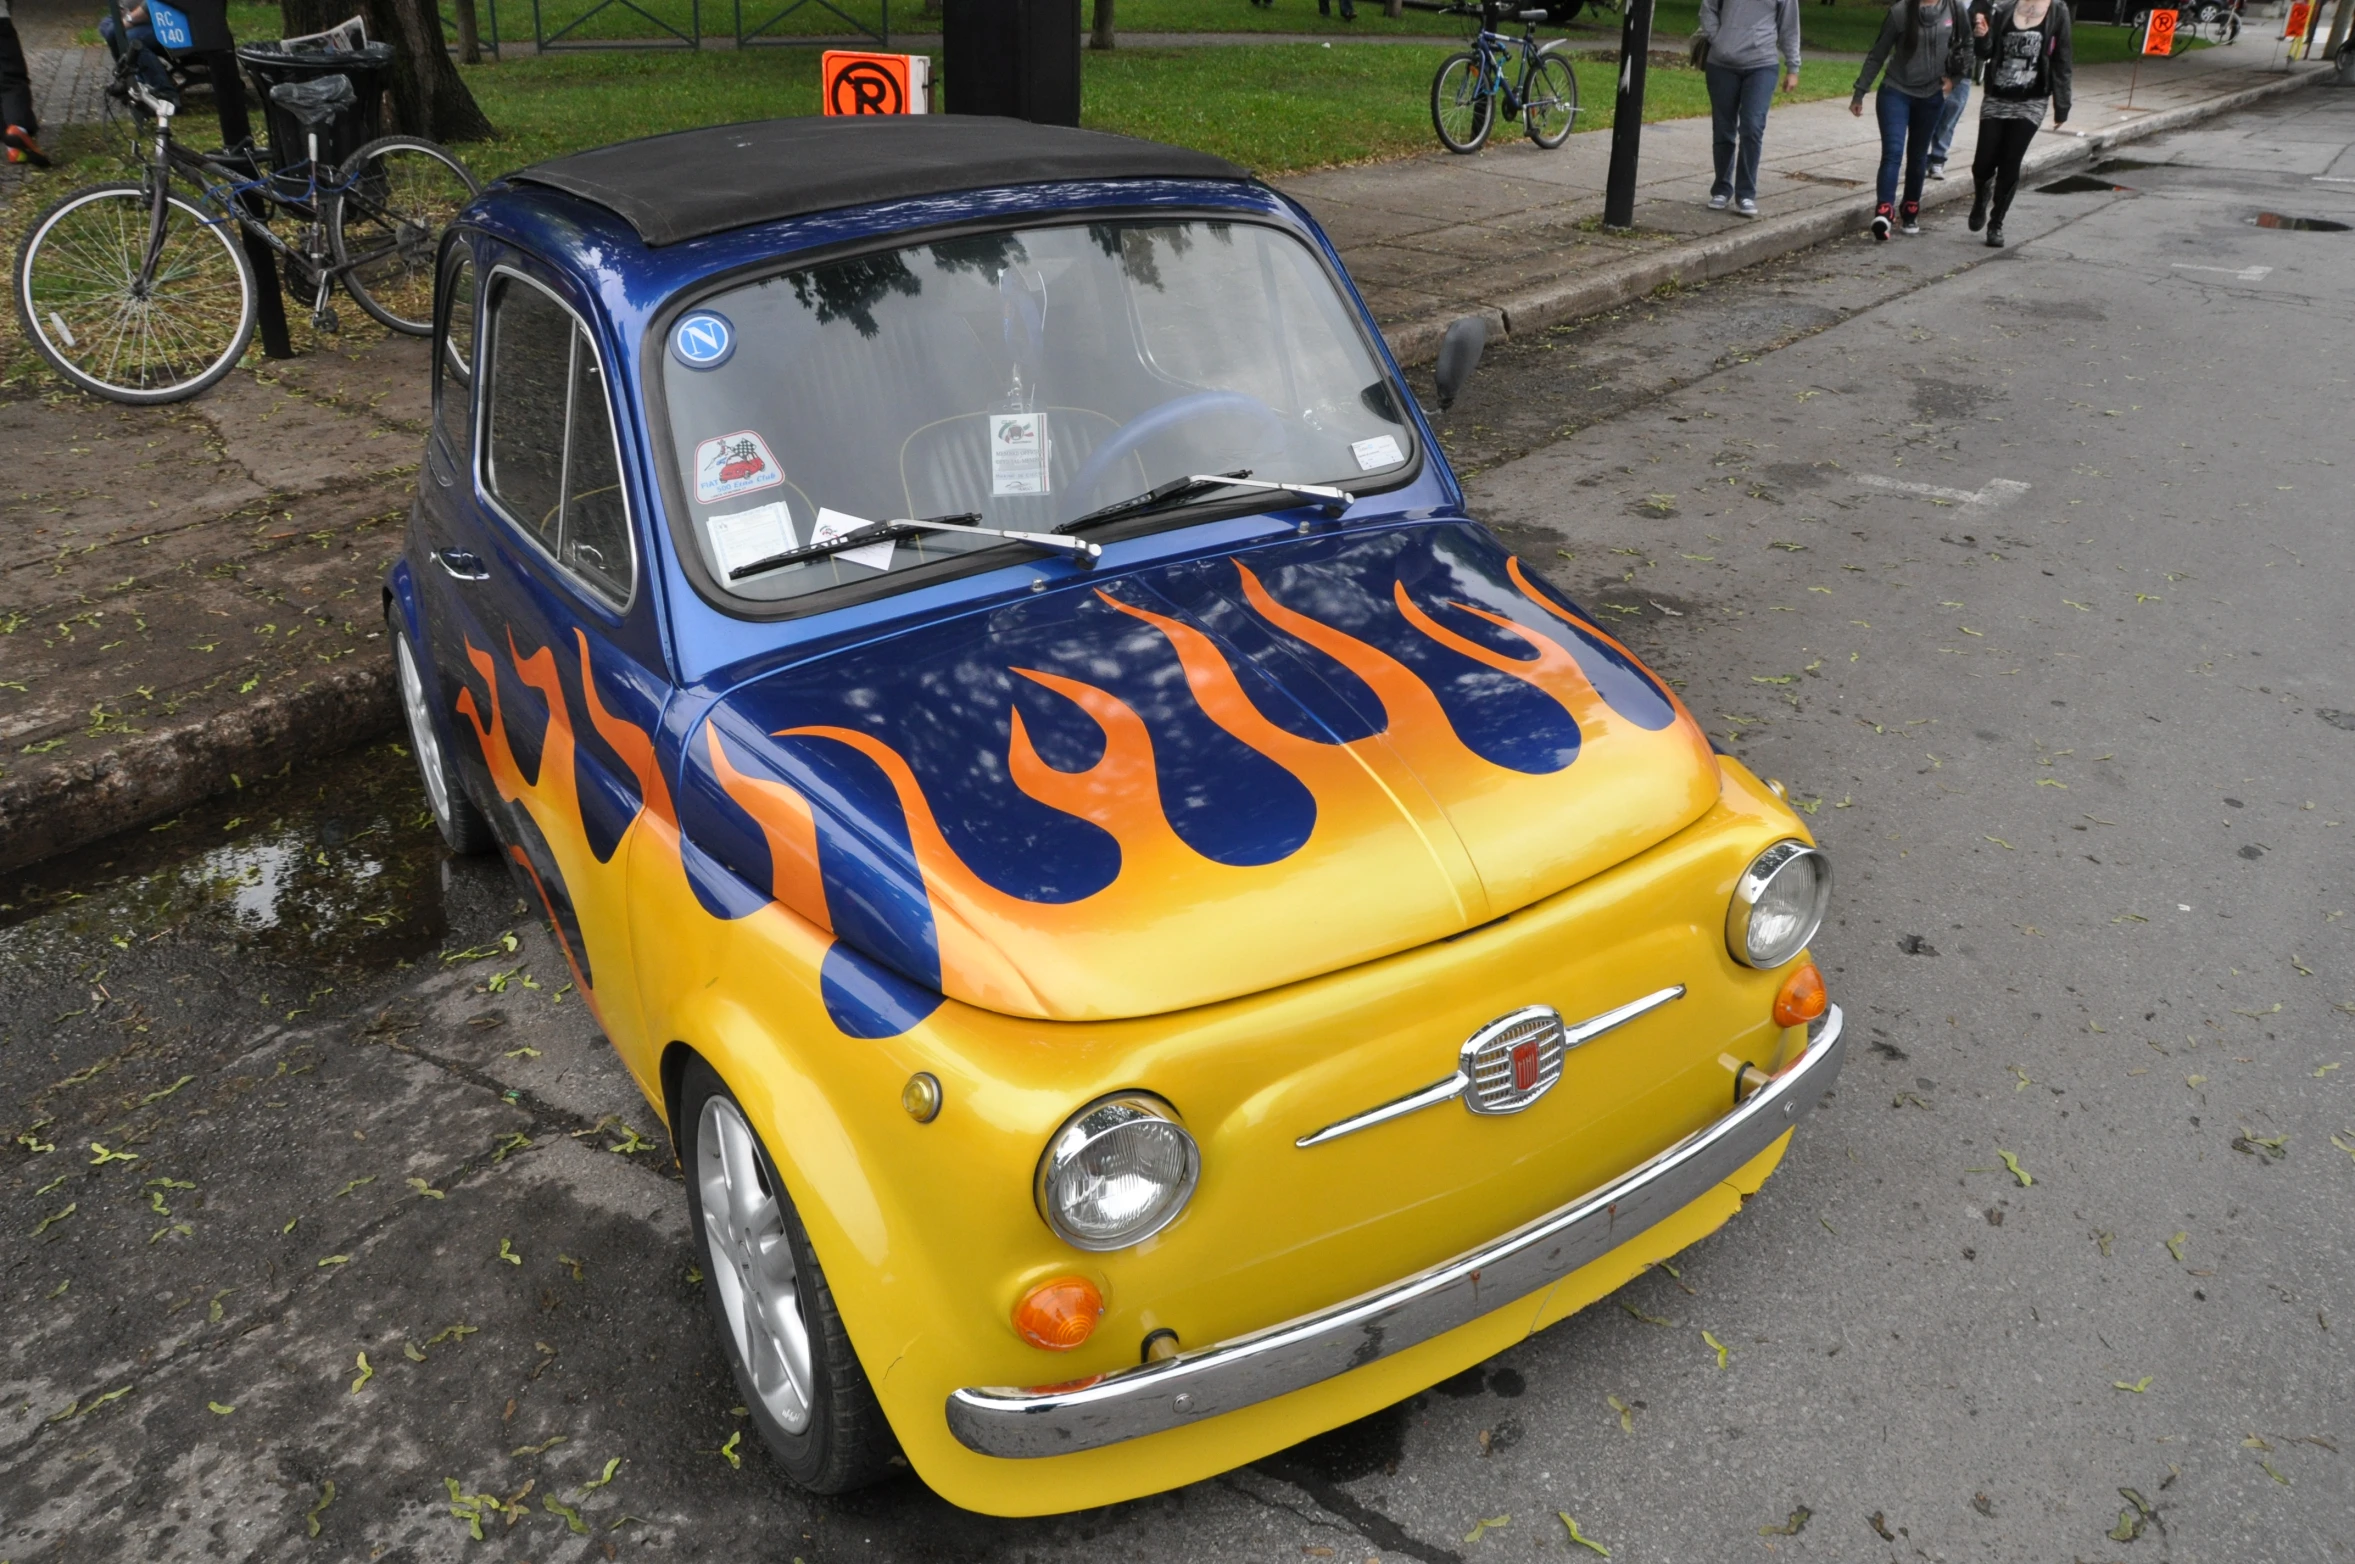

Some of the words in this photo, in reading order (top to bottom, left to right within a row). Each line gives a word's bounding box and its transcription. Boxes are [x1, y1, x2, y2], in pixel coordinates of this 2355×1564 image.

[155, 11, 174, 27] RC
[161, 28, 184, 44] 140
[684, 321, 718, 355] N
[700, 479, 719, 489] FIAT
[717, 484, 732, 493] 500
[734, 480, 754, 489] Etna
[757, 472, 776, 482] Club
